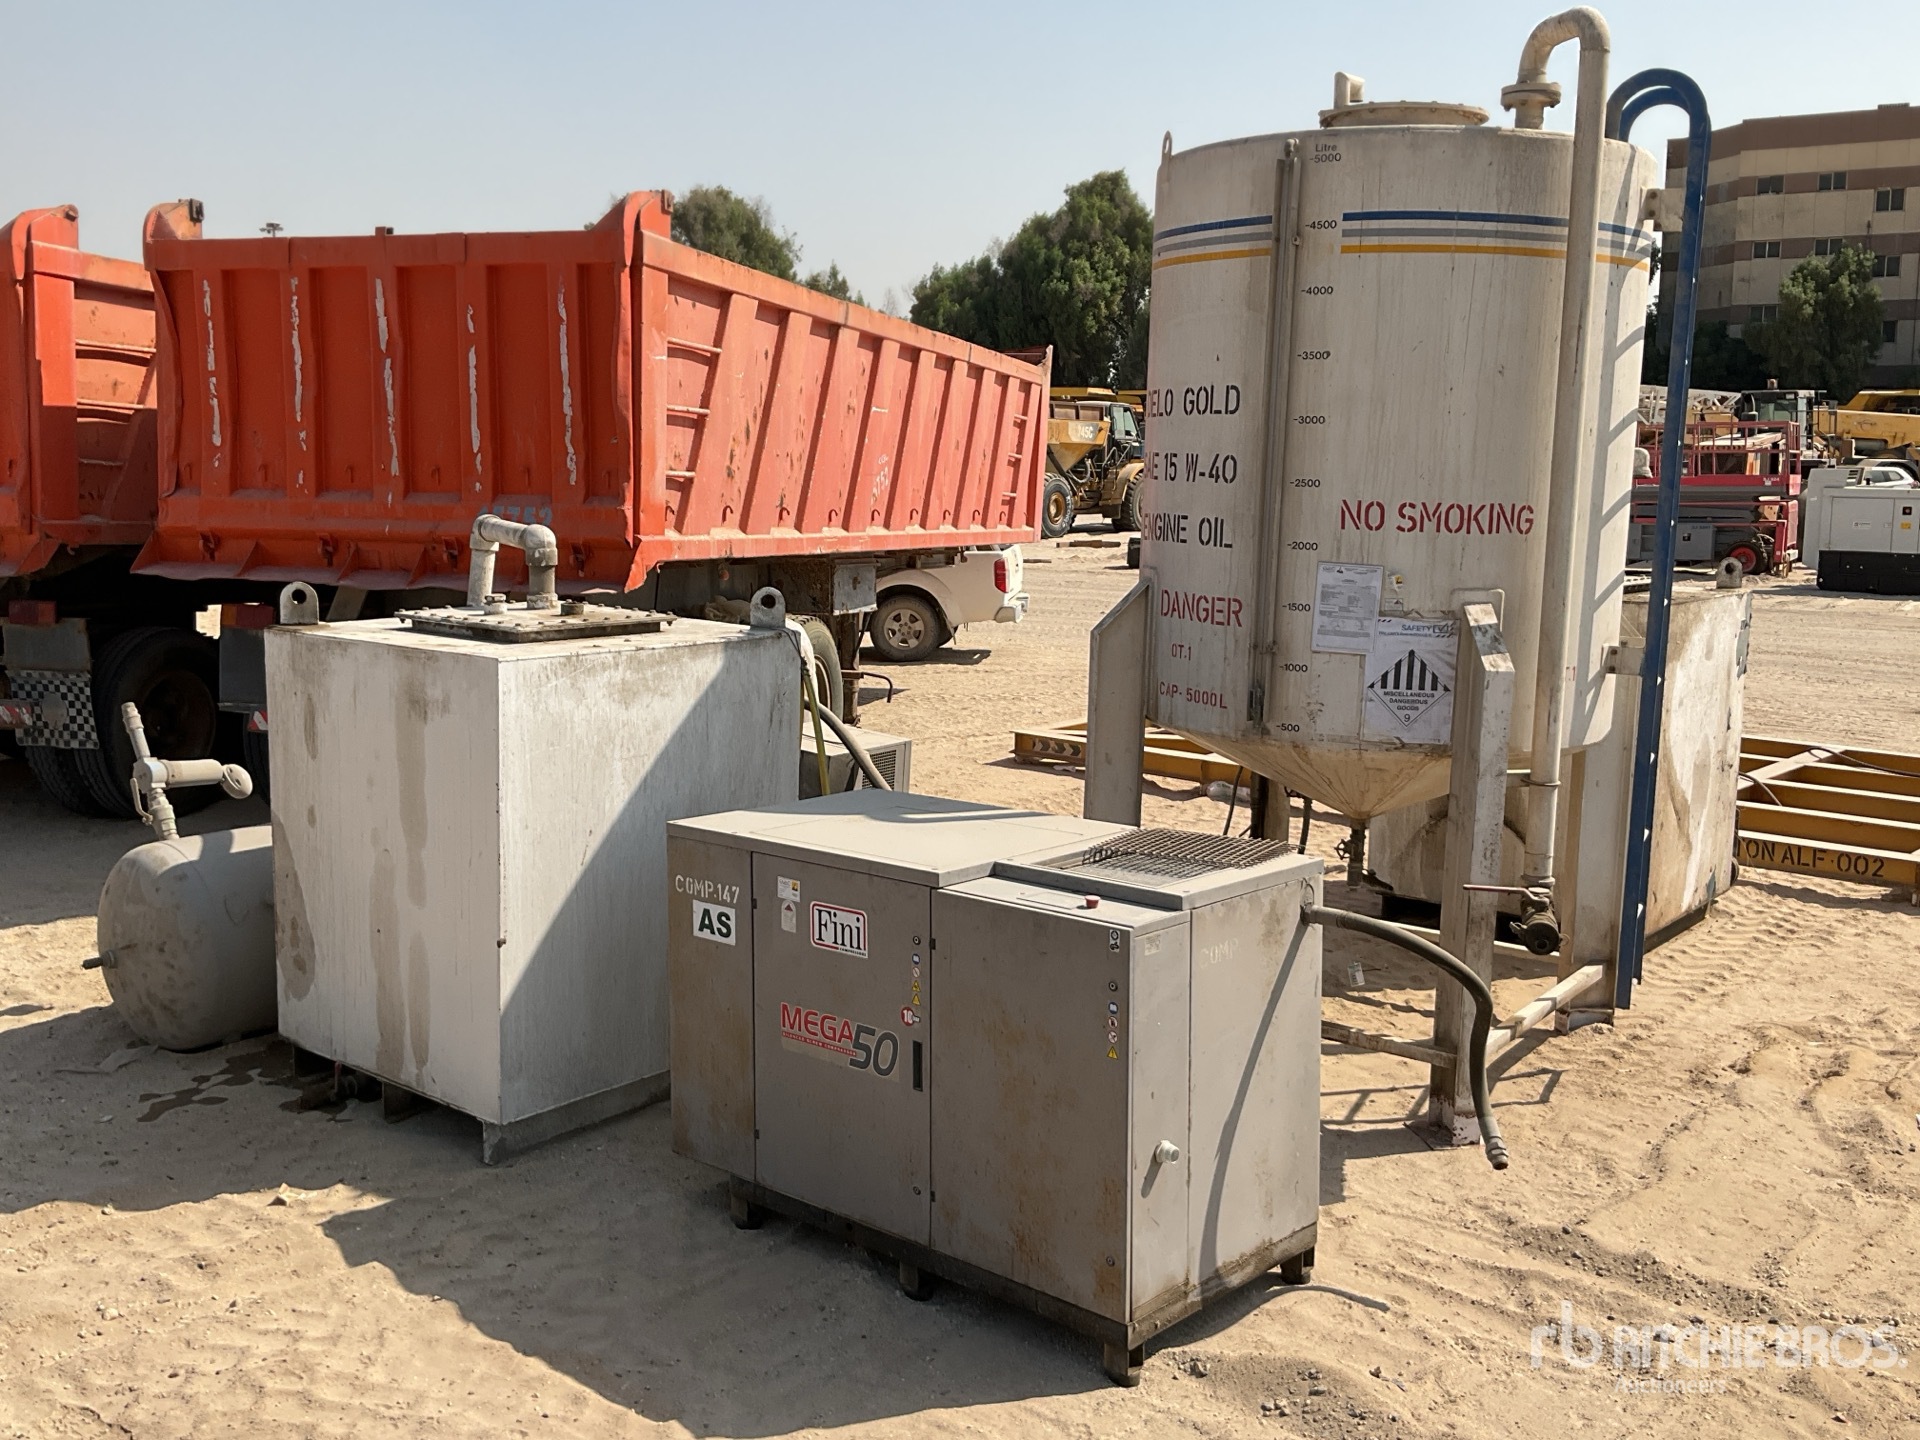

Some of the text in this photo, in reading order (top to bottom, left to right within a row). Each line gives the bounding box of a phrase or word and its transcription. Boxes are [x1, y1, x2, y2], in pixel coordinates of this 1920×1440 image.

[1315, 143, 1337, 152] Litre
[1183, 384, 1241, 416] GOLD
[1164, 452, 1178, 481] 15
[1340, 499, 1535, 535] NO SMOKING
[1198, 516, 1233, 549] OIL
[1160, 588, 1243, 628] DANGER
[1401, 624, 1432, 632] SAFETY
[1383, 690, 1435, 698] MISCELLANEOUS
[1389, 697, 1429, 705] DANGEROUS
[1403, 713, 1411, 723] 9
[698, 907, 732, 938] AS
[815, 907, 863, 951] Fini
